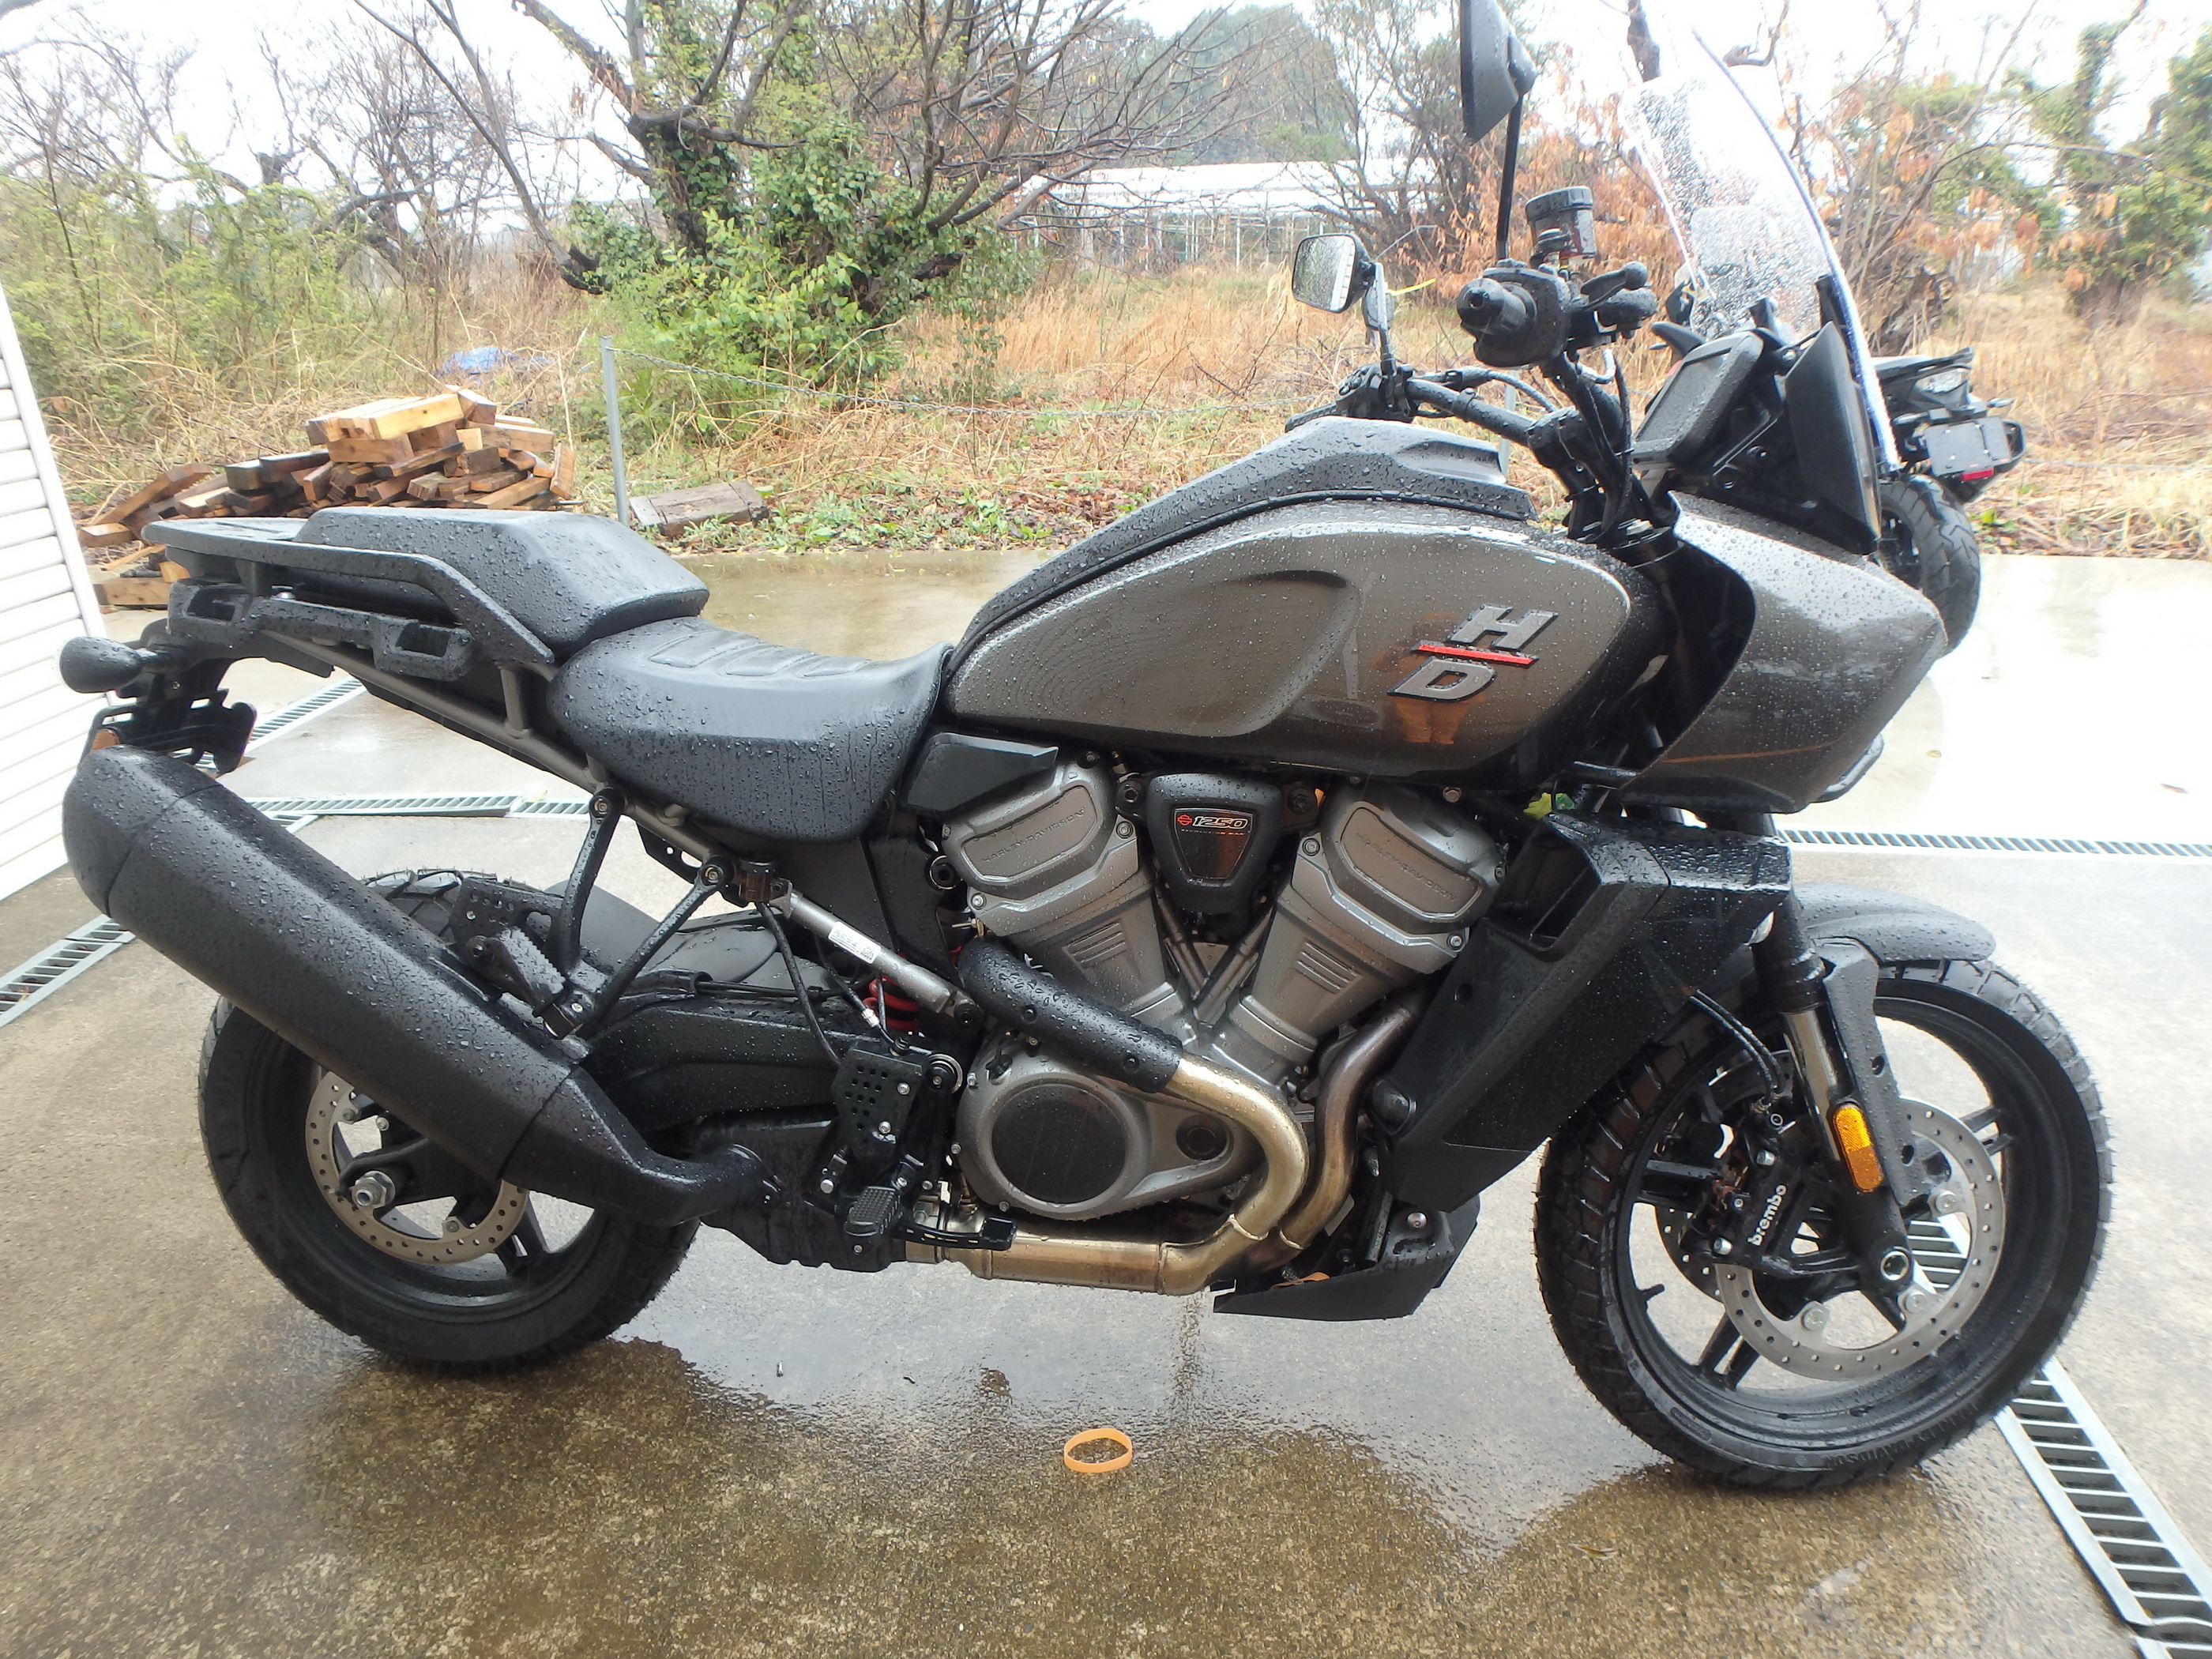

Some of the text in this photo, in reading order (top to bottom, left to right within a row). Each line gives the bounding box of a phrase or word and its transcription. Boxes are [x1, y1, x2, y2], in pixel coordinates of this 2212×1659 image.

[1446, 603, 1559, 651] H
[1387, 656, 1497, 702] D
[981, 807, 1085, 863] HARLEY-DAVIDSON
[1192, 816, 1248, 829] 1250
[1747, 1184, 1788, 1247] brembo
